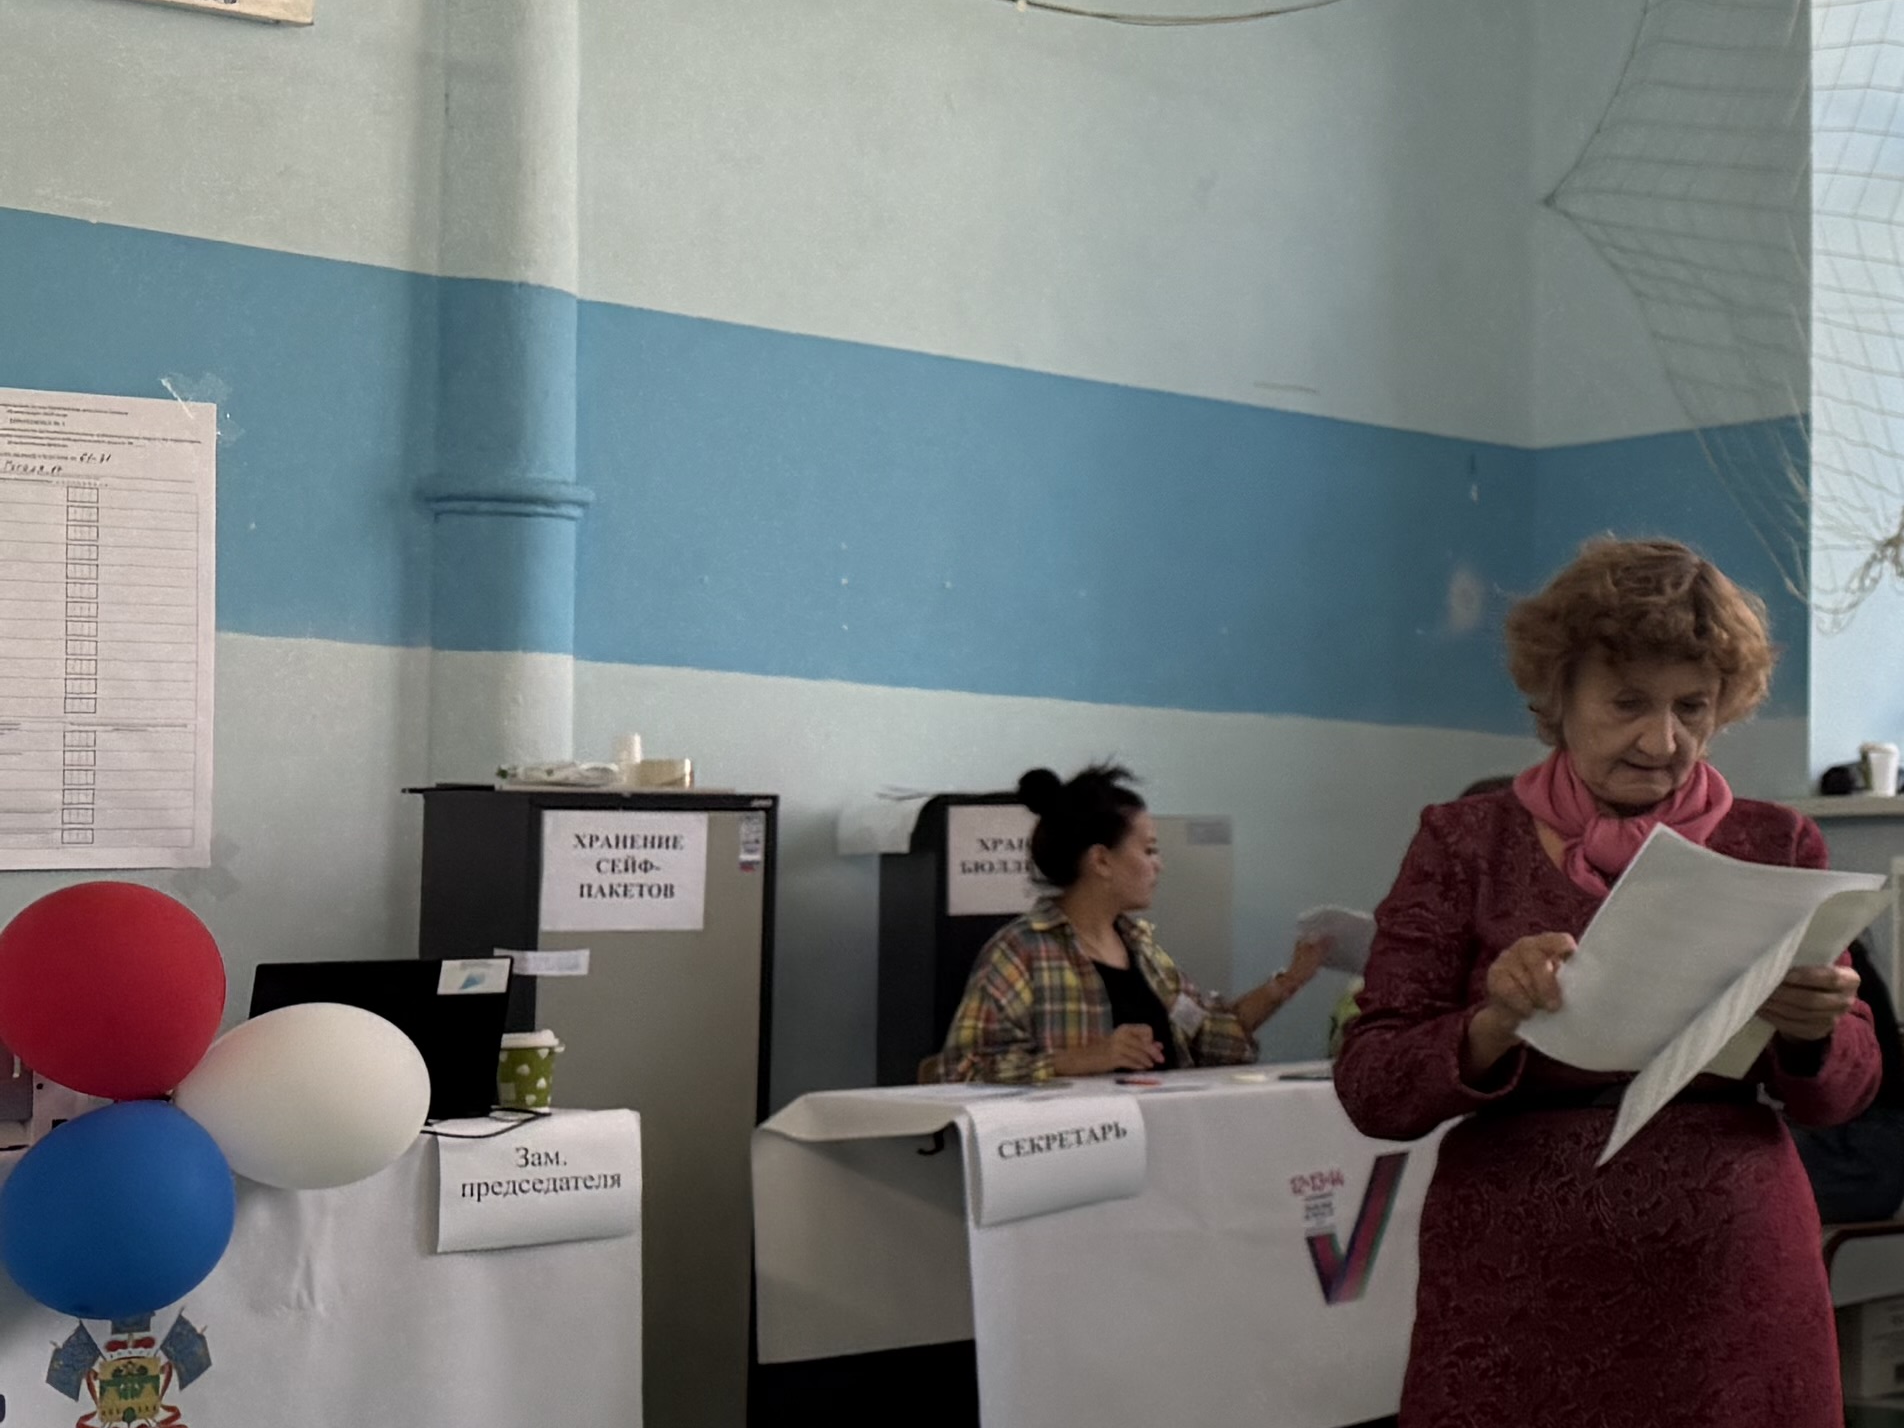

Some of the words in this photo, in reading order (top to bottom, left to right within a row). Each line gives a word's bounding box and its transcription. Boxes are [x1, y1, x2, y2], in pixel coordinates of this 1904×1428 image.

[573, 833, 684, 851] ХРАНЕНИЕ
[595, 856, 662, 875] СЕЙФ-
[578, 883, 676, 900] ПАКЕТОВ
[997, 1121, 1128, 1160] СЕКРЕТАРЬ
[515, 1146, 568, 1169] Зам.
[461, 1173, 622, 1203] председателя
